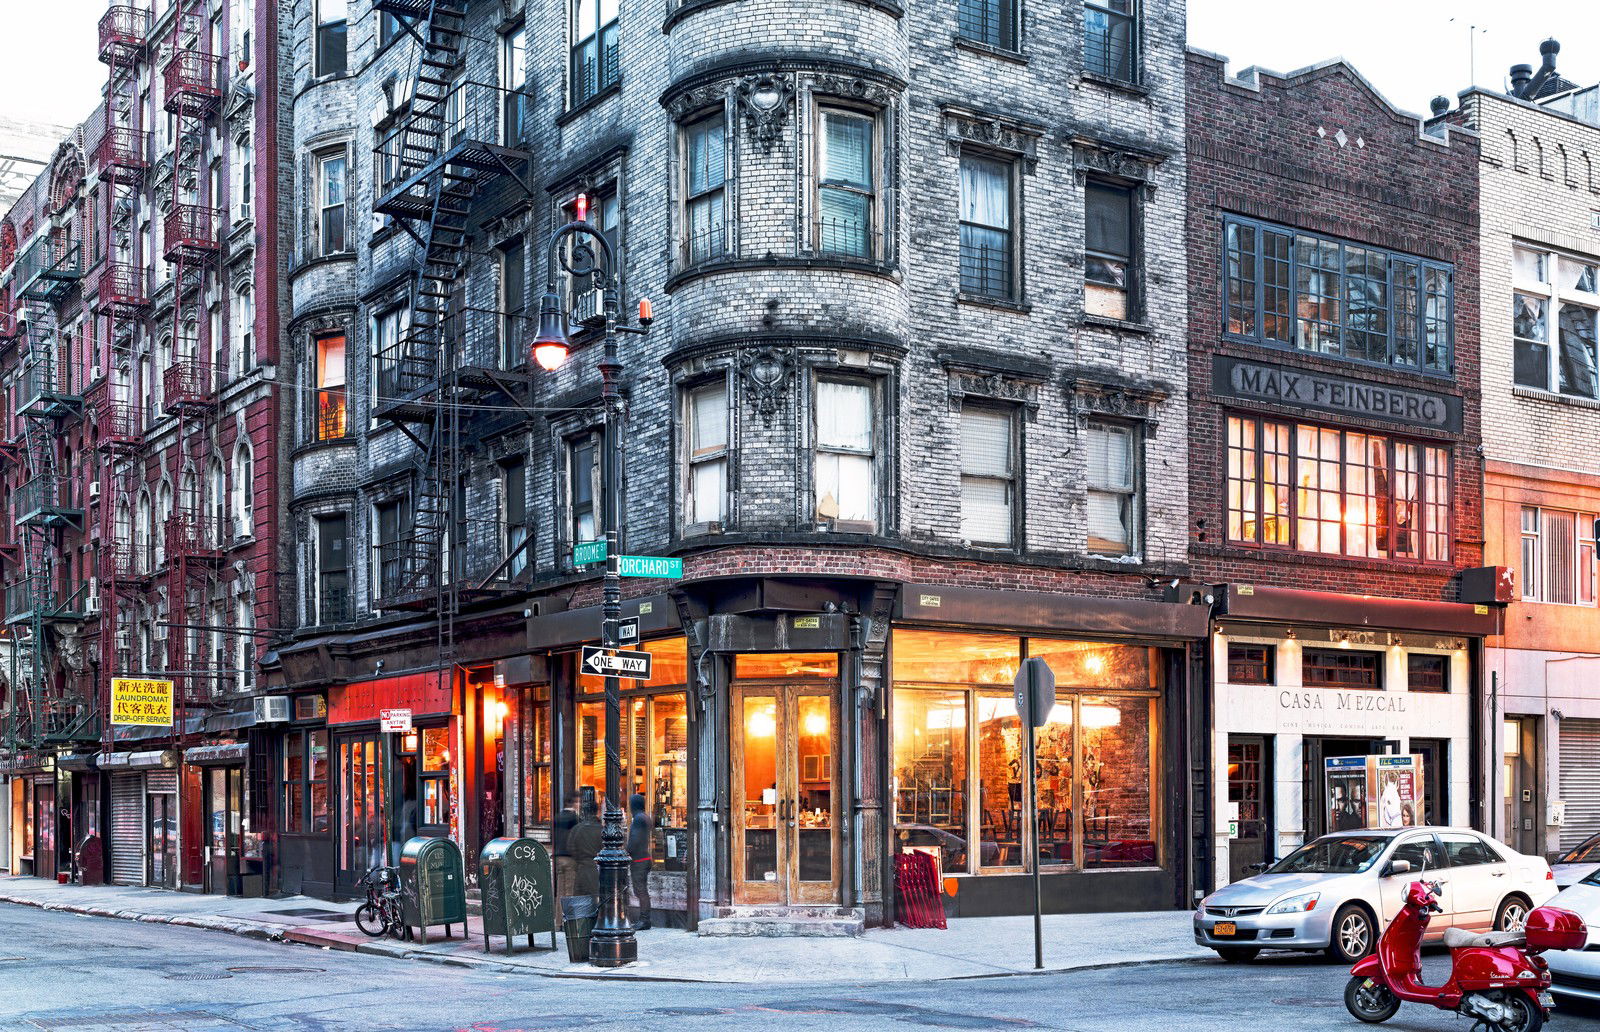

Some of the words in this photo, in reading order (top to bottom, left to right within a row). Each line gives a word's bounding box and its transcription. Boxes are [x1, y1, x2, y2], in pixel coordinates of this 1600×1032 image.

[1240, 368, 1300, 399] MAX
[1312, 380, 1436, 421] FEINBERG
[575, 544, 600, 562] BROOME
[622, 557, 669, 575] ORCHARD
[669, 560, 679, 569] ST
[622, 626, 635, 638] WAY
[593, 656, 613, 668] ONE
[622, 659, 642, 671] WAY
[118, 702, 167, 715] 代客洗衣
[1229, 823, 1236, 835] B
